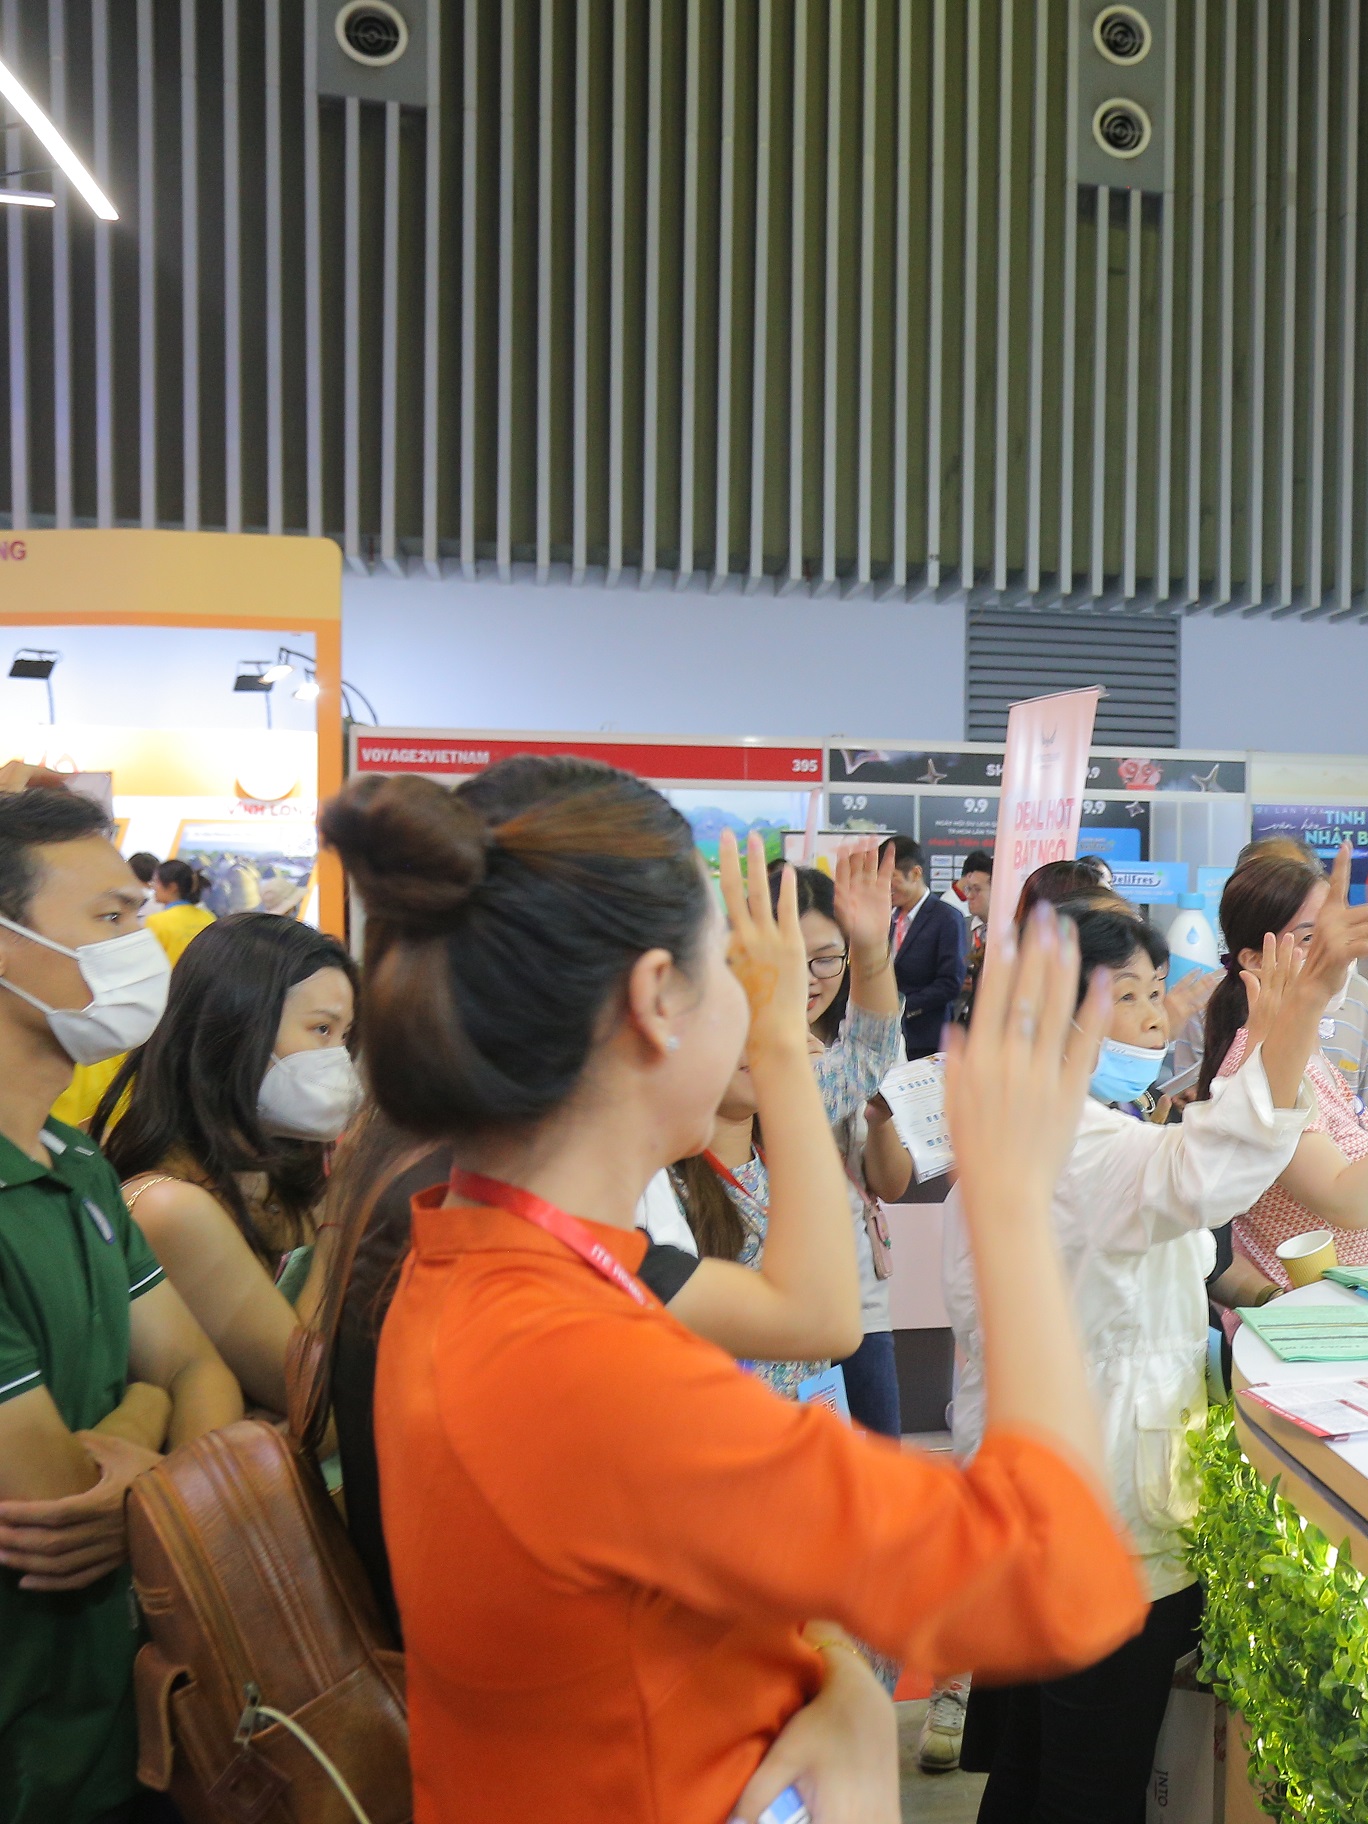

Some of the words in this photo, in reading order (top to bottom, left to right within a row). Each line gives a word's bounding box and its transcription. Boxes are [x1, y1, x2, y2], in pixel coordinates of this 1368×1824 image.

[361, 748, 491, 764] VOYAGE2VIETNAM
[792, 759, 818, 773] 395
[842, 796, 868, 811] 9.9
[964, 798, 989, 814] 9.9
[1083, 800, 1107, 815] 9.9
[1014, 801, 1045, 832] DEAL
[1046, 798, 1076, 830] HOT
[1154, 1766, 1169, 1808] JNTO
